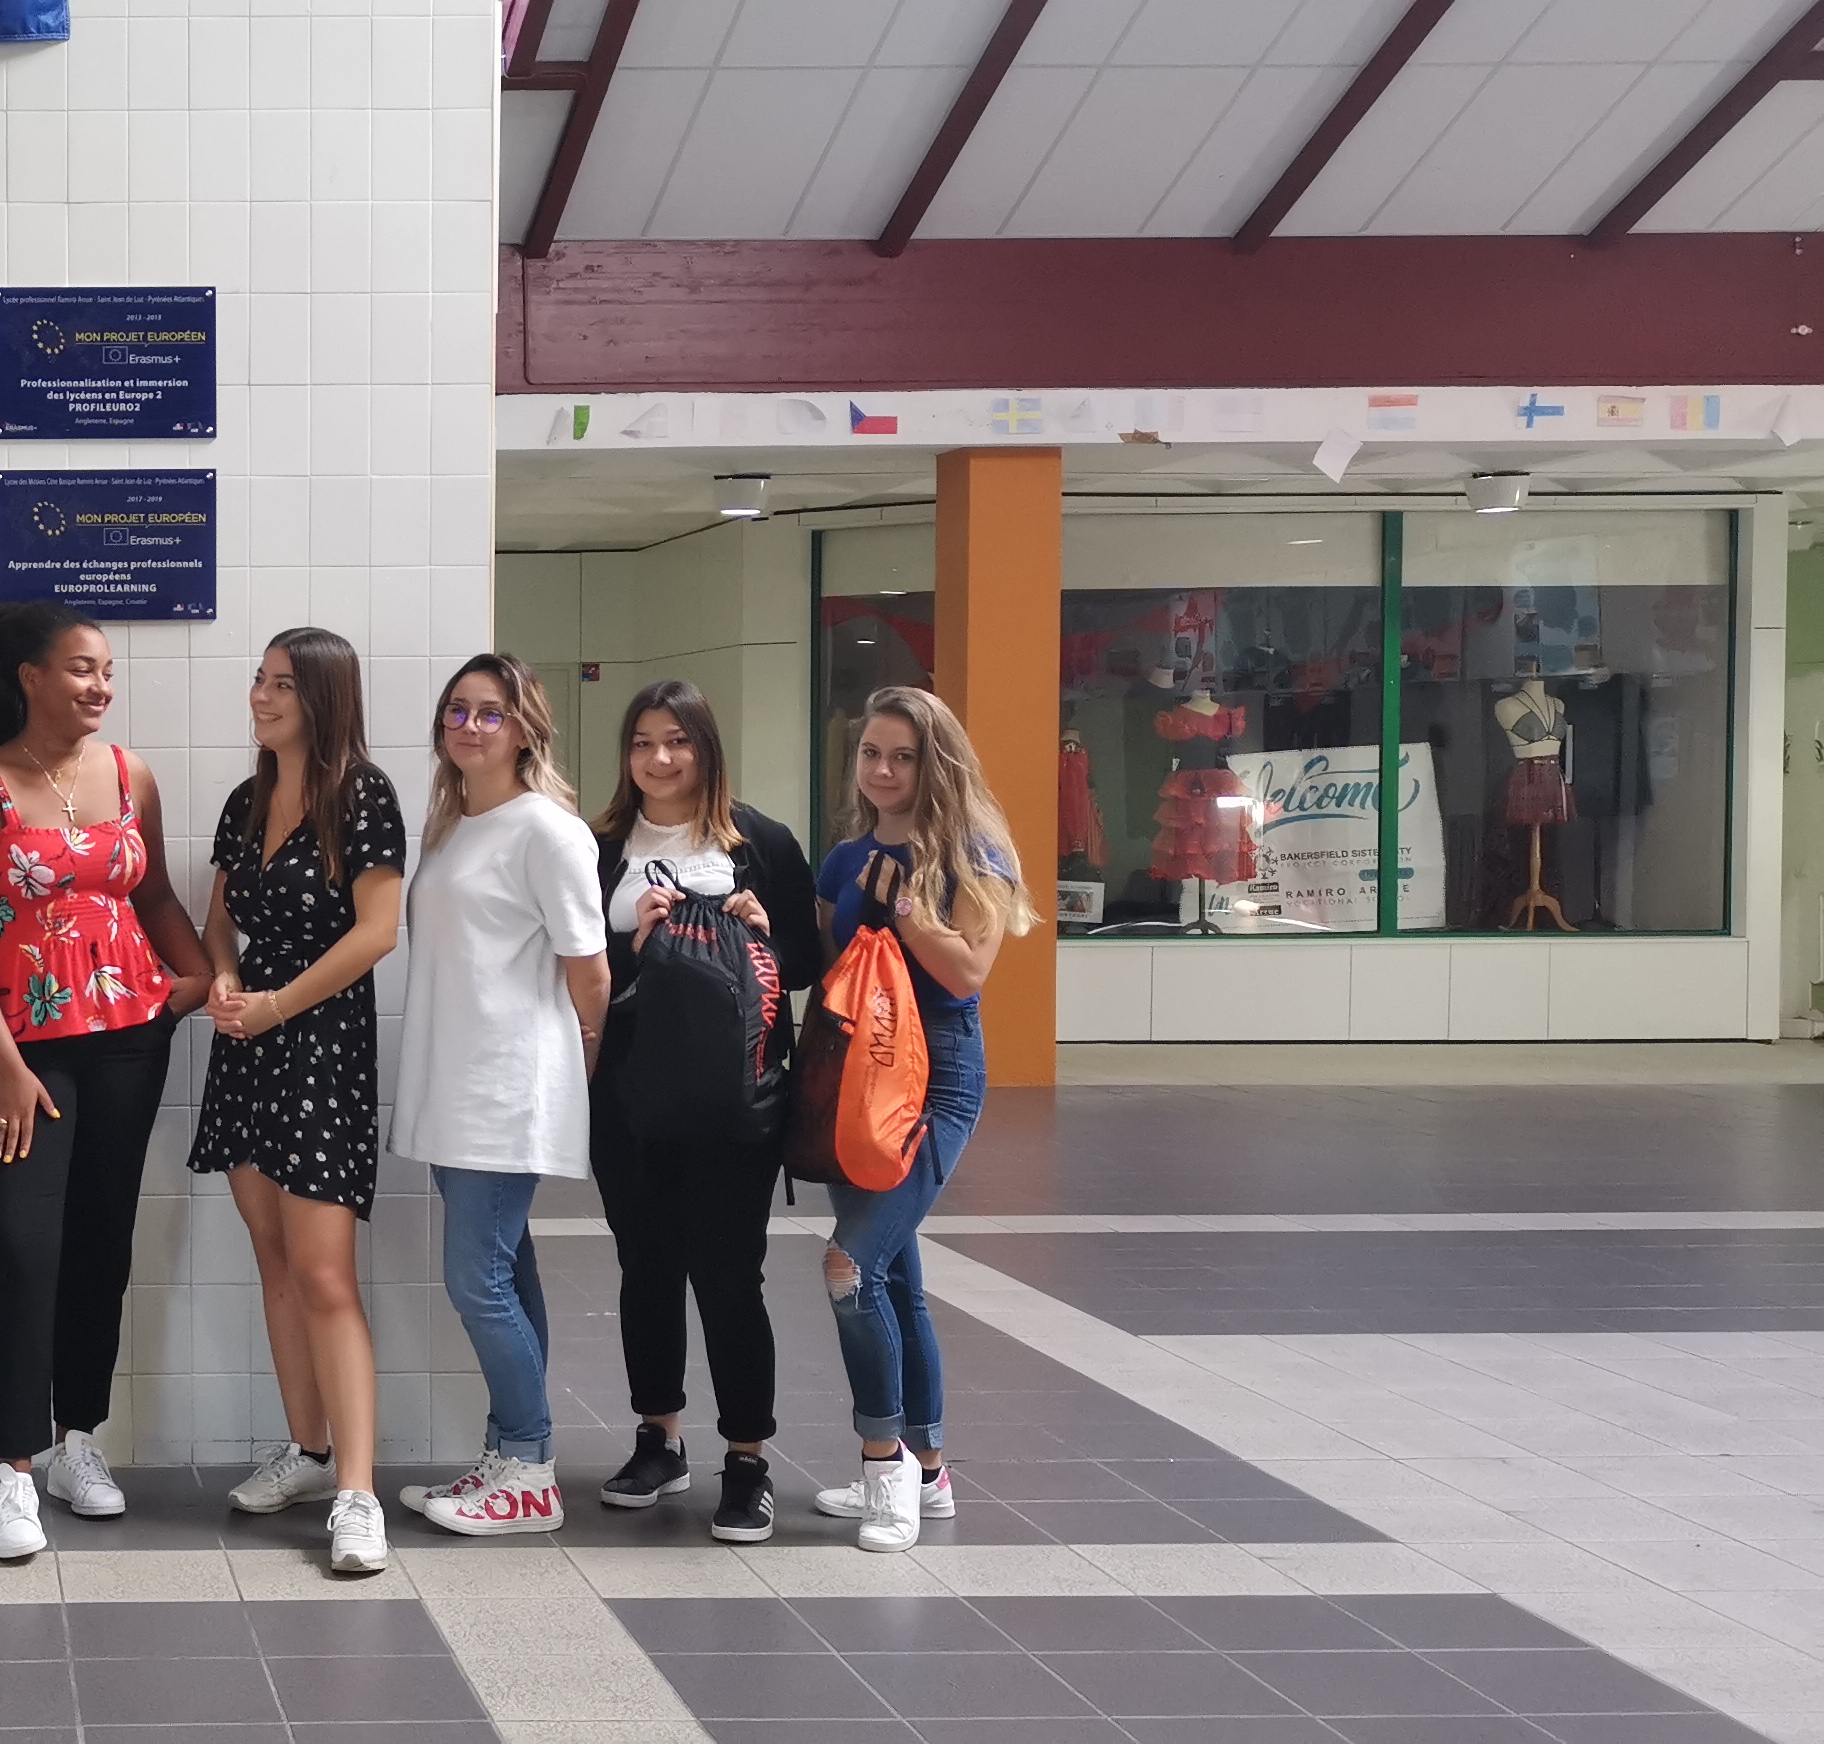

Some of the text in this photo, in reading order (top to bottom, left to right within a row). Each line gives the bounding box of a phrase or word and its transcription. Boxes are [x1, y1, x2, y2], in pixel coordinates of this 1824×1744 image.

[76, 330, 205, 341] MON PROJET EUROPÉEN
[130, 355, 181, 363] Erasmus+
[20, 379, 121, 387] Professionnalisation
[136, 379, 188, 387] immersion
[47, 391, 63, 399] des
[67, 391, 102, 401] lycéens
[119, 391, 154, 401] Europe
[156, 391, 162, 399] 2
[69, 403, 140, 412] PROFILEURO2
[77, 512, 206, 523] MON PROJET EUROPÉEN
[130, 536, 181, 545] Erasmus+
[8, 560, 202, 570] Apprendre des échanges professionnels
[80, 572, 131, 582] européens
[55, 584, 156, 592] EUROPROLEARNING
[1280, 850, 1349, 861] BAKERSFIELD
[1285, 887, 1346, 899] RAMIRO
